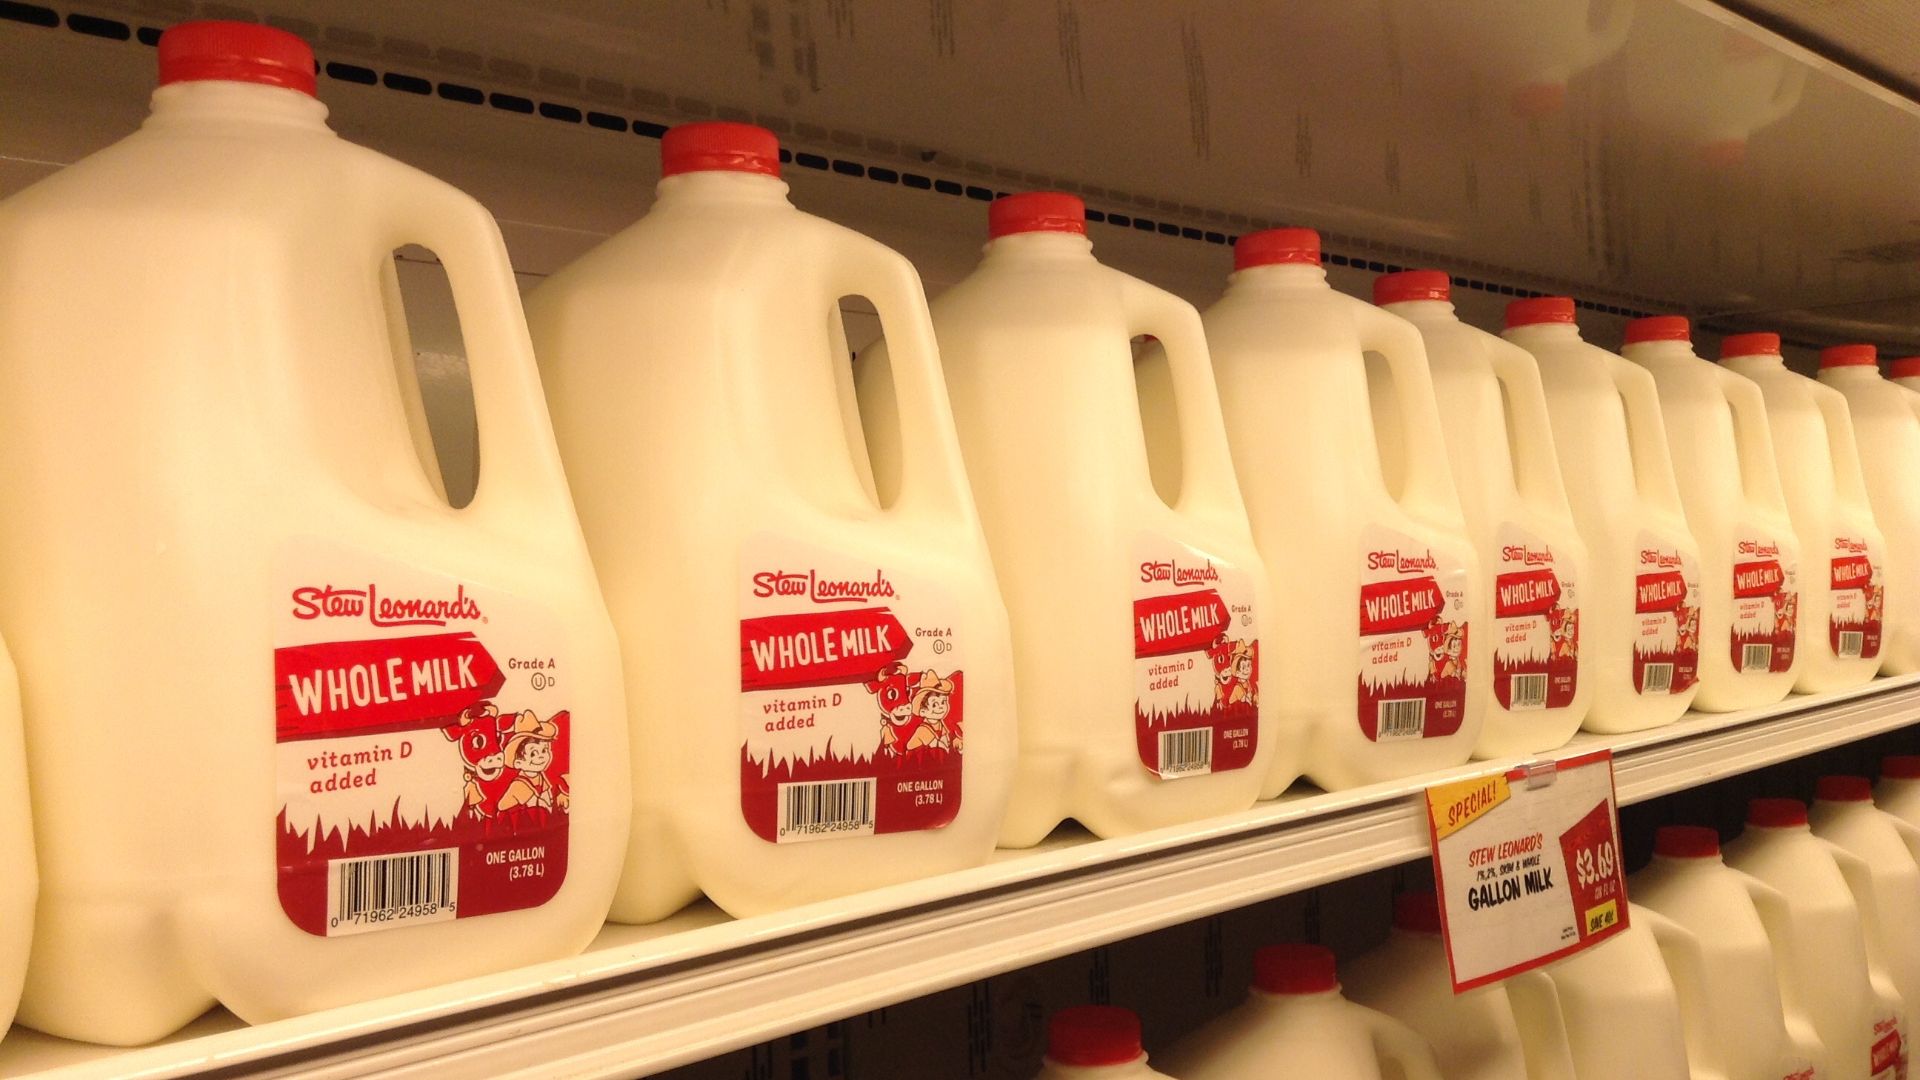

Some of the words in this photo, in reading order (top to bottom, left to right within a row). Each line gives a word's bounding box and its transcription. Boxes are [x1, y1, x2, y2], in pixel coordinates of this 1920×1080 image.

[1368, 552, 1395, 571] Stew
[1396, 549, 1437, 573] Leonard's
[1141, 561, 1171, 583] Stew
[1172, 559, 1219, 587] Leonard's
[1737, 569, 1764, 591] WHOLE
[753, 571, 808, 598] Stew
[810, 569, 895, 603] Leonard's
[1501, 580, 1536, 607] WHOLE
[1536, 579, 1555, 599] MILK
[1640, 581, 1667, 604] WHOLE
[292, 585, 367, 619] Stew
[369, 584, 481, 627] Leonard's
[1365, 590, 1411, 623] WHOLE
[1411, 589, 1436, 611] MILK
[915, 627, 944, 638] Grade
[946, 628, 952, 637] A
[1139, 605, 1191, 643] WHOLE
[1191, 603, 1220, 629] MILK
[1505, 623, 1531, 632] vitamin
[750, 627, 840, 672] WHOLE
[841, 625, 891, 657] MILK
[1371, 640, 1405, 653] vitamin
[1406, 638, 1412, 648] D
[1506, 633, 1527, 644] added
[508, 658, 545, 670] Grade
[547, 658, 556, 669] A
[1149, 661, 1185, 677] vitamin
[1187, 659, 1194, 671] D
[1372, 652, 1398, 665] added
[289, 657, 407, 716] WHOLE
[411, 654, 478, 694] MILK
[1150, 677, 1179, 691] added
[763, 696, 827, 714] vitamin
[833, 693, 842, 706] D
[765, 714, 815, 732] added
[307, 745, 393, 770] vitamin
[400, 742, 412, 758] D
[310, 769, 377, 794] added
[897, 782, 913, 793] ONE
[914, 779, 943, 791] GALLON
[915, 795, 935, 807] (3.78
[935, 794, 942, 805] L)
[1448, 780, 1497, 827] SPECIAL!
[797, 823, 827, 835] 71962
[486, 850, 507, 866] ONE
[508, 847, 545, 863] GALLON
[1469, 845, 1496, 868] STEW
[1498, 832, 1543, 860] LEONARD'S
[509, 864, 534, 881] (3.78
[535, 863, 545, 878] L)
[1576, 841, 1614, 890] $3.69
[1469, 876, 1521, 911] GALLON
[1524, 867, 1554, 896] MILK
[354, 908, 394, 925] 71962
[399, 903, 437, 919] 24958
